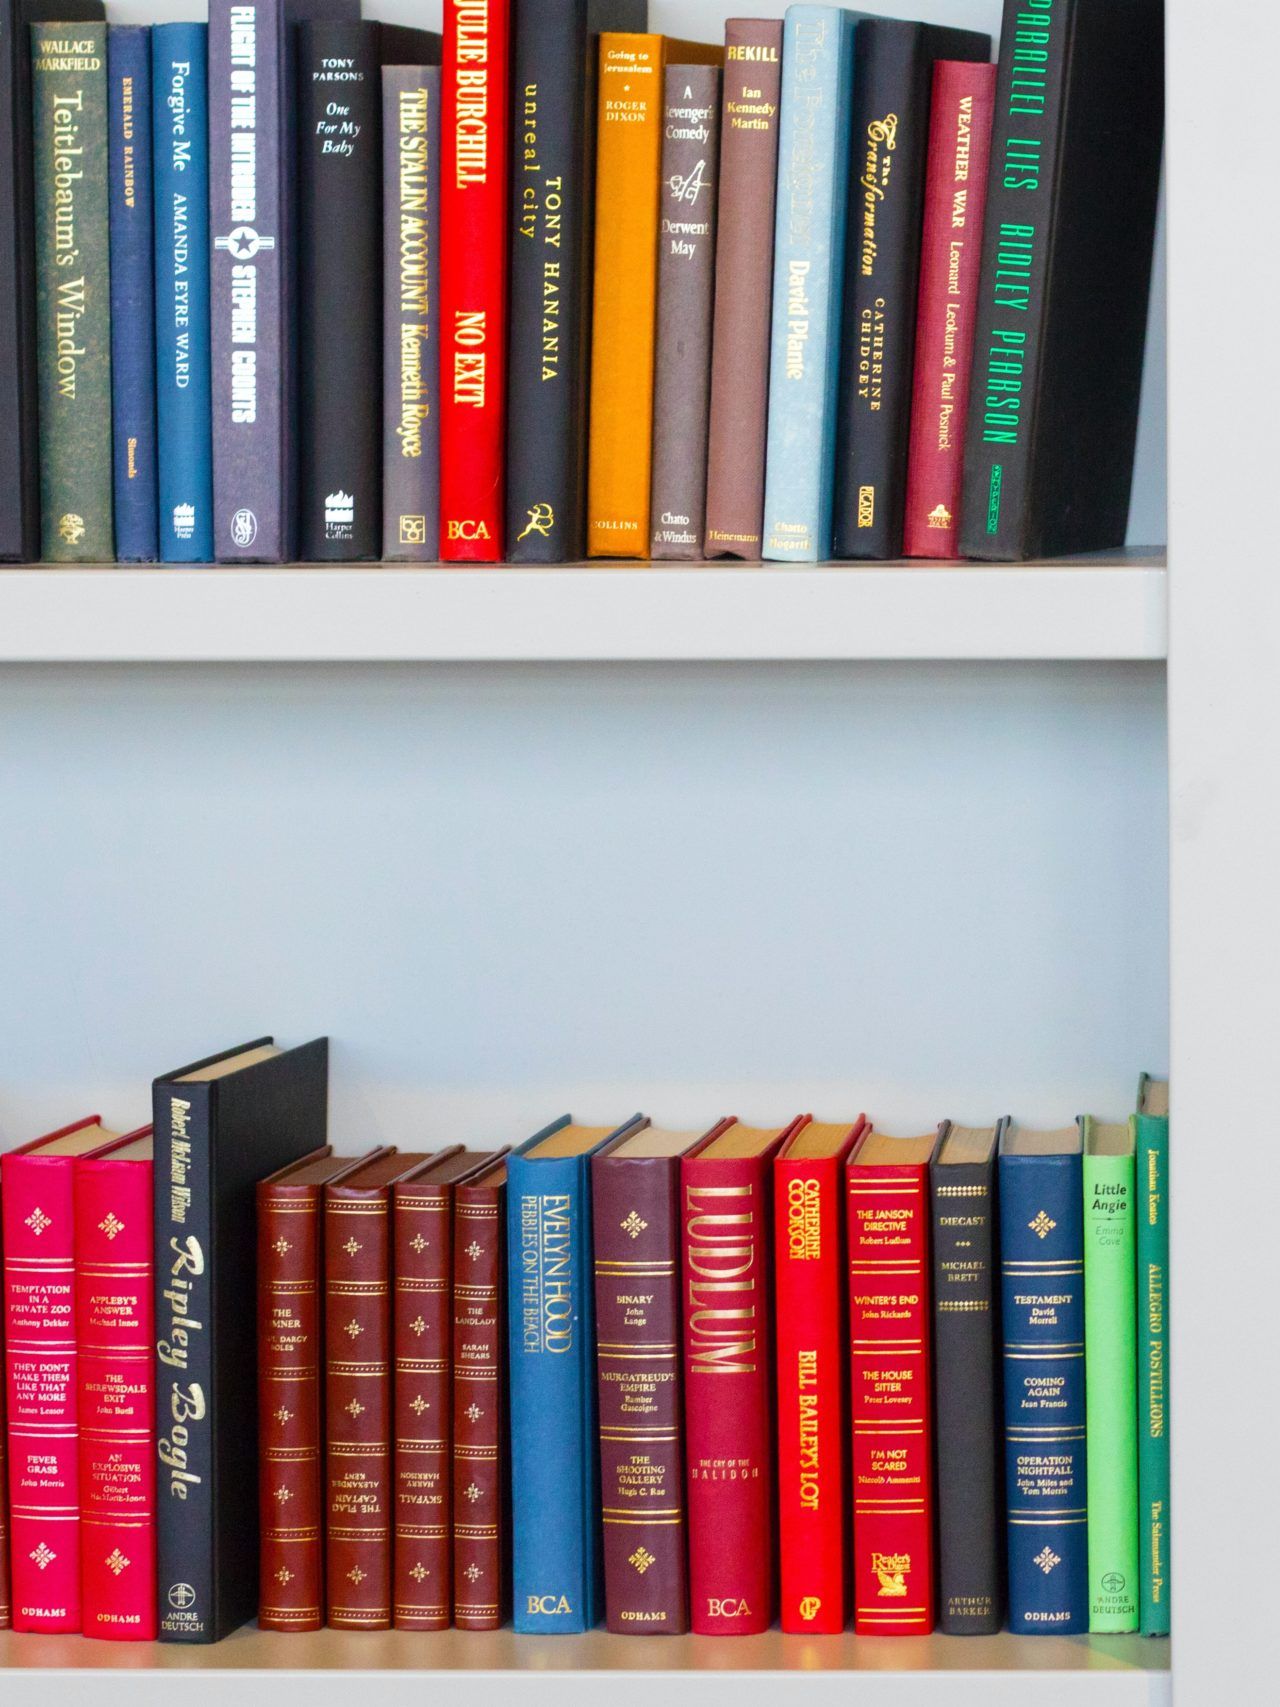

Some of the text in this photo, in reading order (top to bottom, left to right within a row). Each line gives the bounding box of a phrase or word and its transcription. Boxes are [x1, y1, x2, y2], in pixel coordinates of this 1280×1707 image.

[40, 40, 95, 53] WALLACE
[728, 46, 779, 63] REKILL
[36, 58, 100, 71] MARKFIELD
[321, 59, 354, 69] TONY
[312, 73, 364, 82] PARSONS
[742, 87, 762, 99] Ian
[326, 102, 349, 116] One
[728, 103, 776, 118] Kennedy
[316, 121, 361, 137] For My
[732, 118, 769, 130] Martin
[122, 77, 134, 208] EMERALD RAINBOW
[321, 140, 354, 156] Baby
[951, 96, 973, 228] WEATHER WAR
[1003, 139, 1042, 190] LIES
[167, 61, 191, 388] Forgive Me AMANDA EYRE WARD
[53, 90, 85, 399] Teitlebaum's Window
[993, 223, 1035, 311] RIDLEY
[542, 177, 562, 381] TONY HANANIA
[454, 311, 486, 408] NO EXIT
[232, 351, 256, 423] COONTS
[982, 330, 1026, 444] PEARSON
[325, 523, 353, 532] Harper
[447, 520, 491, 540] BCA
[325, 531, 353, 540] Collins
[1094, 1183, 1127, 1196] Little
[1092, 1199, 1127, 1214] Angie
[941, 1217, 986, 1226] DIECAST
[521, 1196, 540, 1353] PEBBLES ON THE BEACH
[544, 1195, 572, 1353] EVELYN HOOD
[686, 1184, 756, 1373] LUDLUM
[11, 1285, 70, 1294] TEMPTATION
[1015, 1295, 1072, 1304] TESTAMENT
[10, 1305, 71, 1314] PRIVATE ZOO
[157, 1235, 206, 1500] Ripley Bogle
[1024, 1377, 1065, 1386] COMING
[1028, 1387, 1060, 1396] AGAIN
[798, 1350, 819, 1510] BILL BAILEY'S LOT
[27, 1455, 57, 1464] FEVER
[1017, 1456, 1073, 1465] OPERATION
[27, 1465, 58, 1474] GRASS
[1018, 1466, 1073, 1475] NIGHTFALL
[527, 1595, 572, 1614] BCA
[708, 1598, 751, 1617] BCA
[22, 1607, 66, 1617] ODHAMS
[167, 1613, 198, 1621] ANDRE
[1024, 1611, 1071, 1621] ODHAMS
[161, 1621, 204, 1632] DEUTSCH
